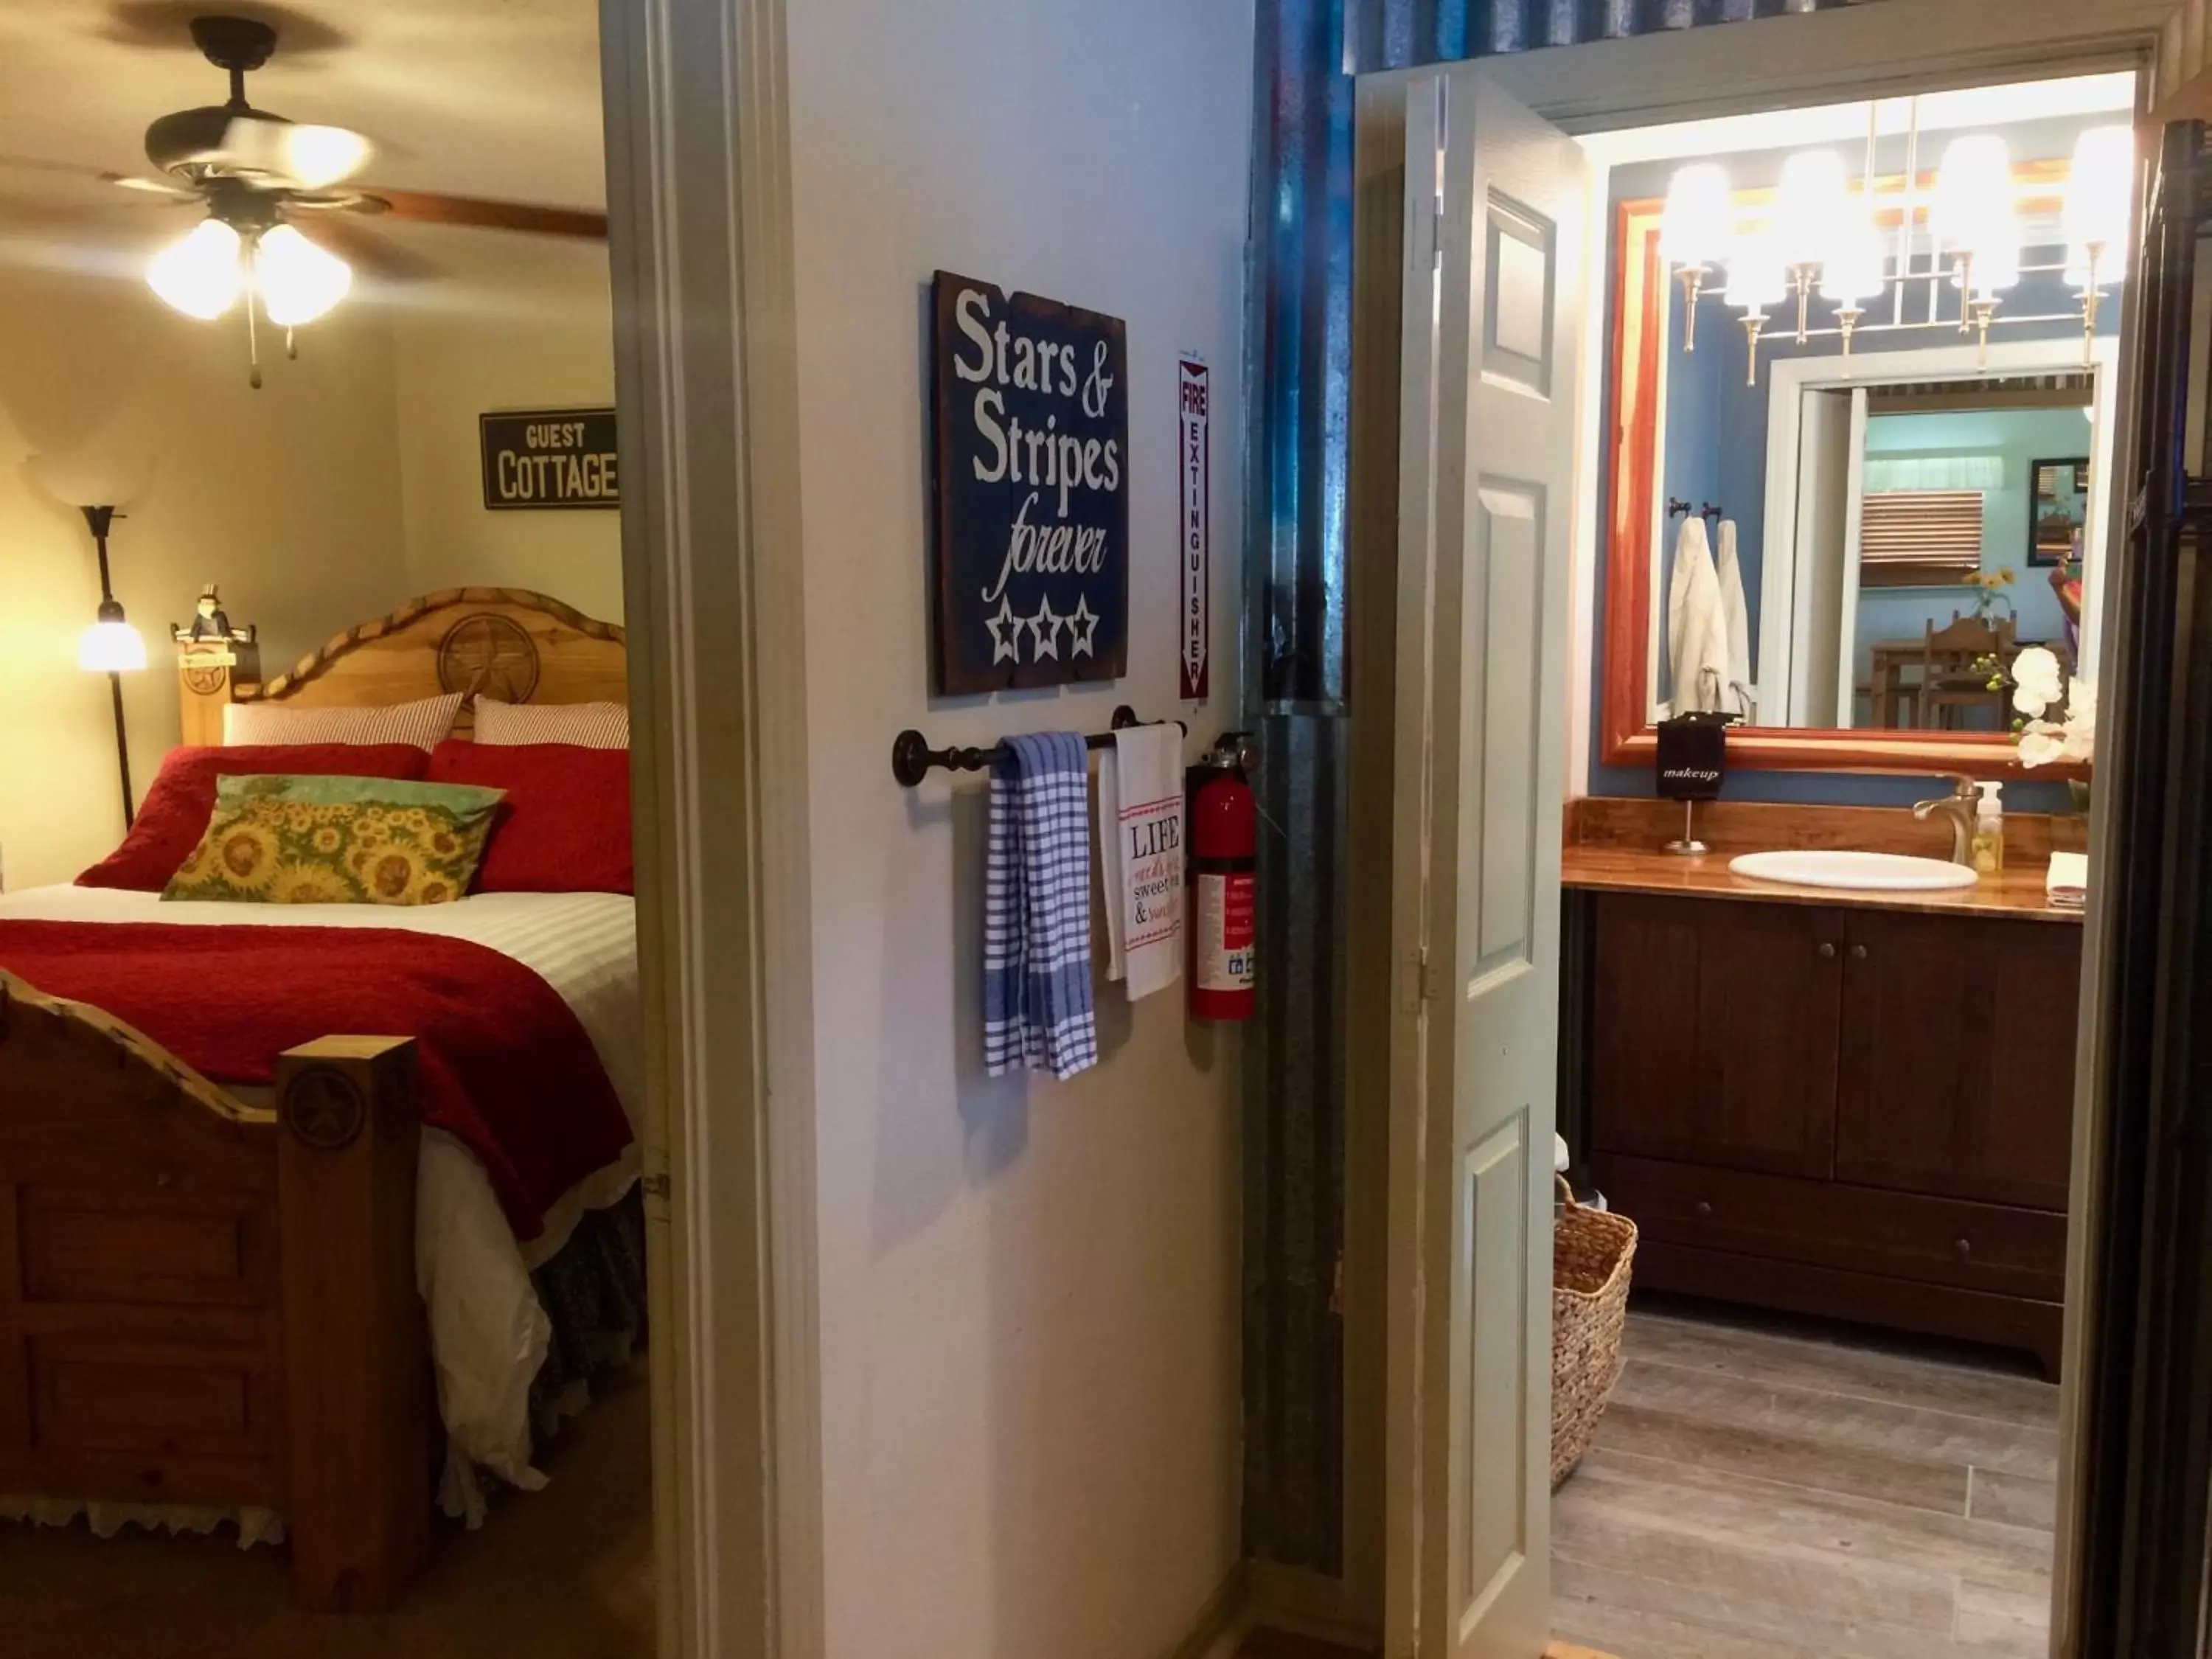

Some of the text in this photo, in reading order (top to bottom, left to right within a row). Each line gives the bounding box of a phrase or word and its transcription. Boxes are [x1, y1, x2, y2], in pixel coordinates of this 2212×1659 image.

[954, 288, 1113, 417] Stars &
[1183, 380, 1205, 416] FIRE
[526, 422, 585, 448] GUEST
[973, 388, 1119, 518] Stripes
[498, 449, 619, 499] COTTAGE
[982, 492, 1107, 602] forever
[1190, 422, 1200, 678] EXTINGUISHER
[1663, 767, 1719, 782] makeup
[1130, 815, 1179, 860] LIFE
[1134, 878, 1169, 900] sweet
[1135, 901, 1147, 924] &
